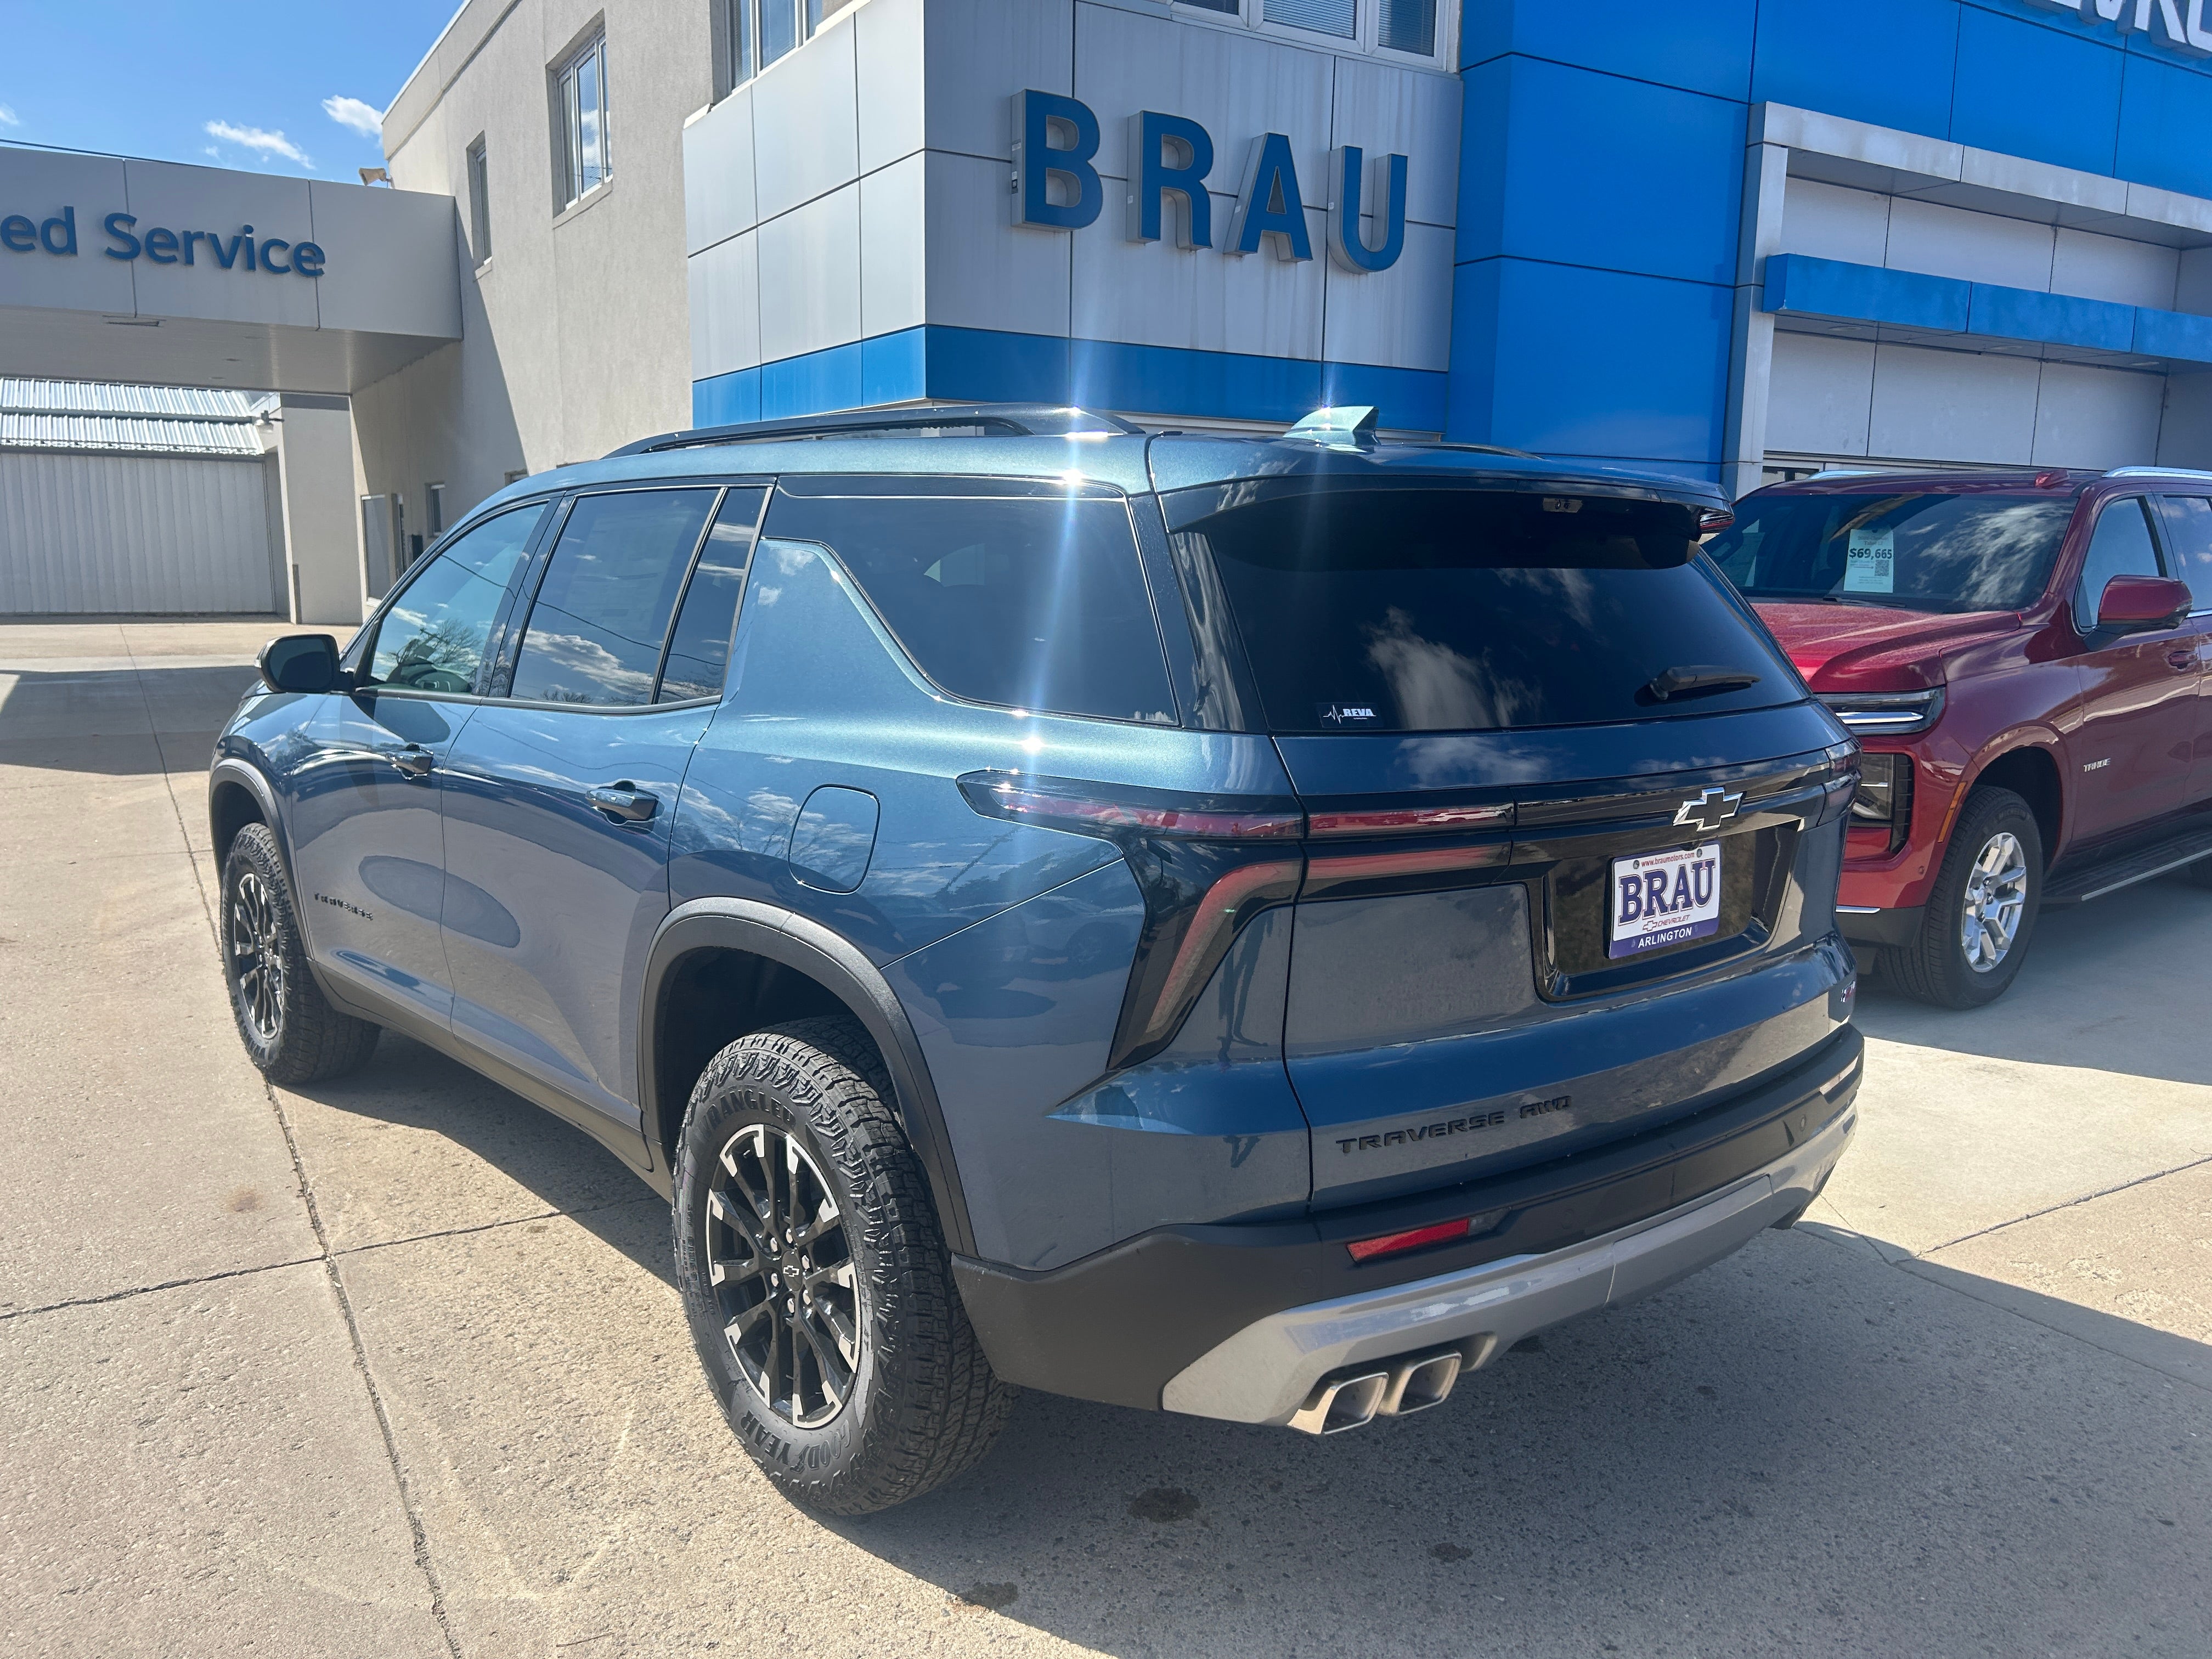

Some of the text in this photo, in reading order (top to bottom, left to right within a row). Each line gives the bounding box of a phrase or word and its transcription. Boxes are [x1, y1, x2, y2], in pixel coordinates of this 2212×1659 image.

[1012, 89, 1409, 274] BRAU
[104, 212, 326, 277] Service
[1849, 548, 1892, 560] $69,665
[1342, 708, 1374, 716] REVA
[1641, 851, 1695, 867] www.braumotors.com
[1618, 858, 1716, 926] BRAU
[1638, 926, 1692, 949] ARLINGTON
[1657, 915, 1691, 927] CHEVROLET
[1335, 1096, 1572, 1153] TRAVERSE AWD
[741, 1409, 851, 1474] GOODYEAR
